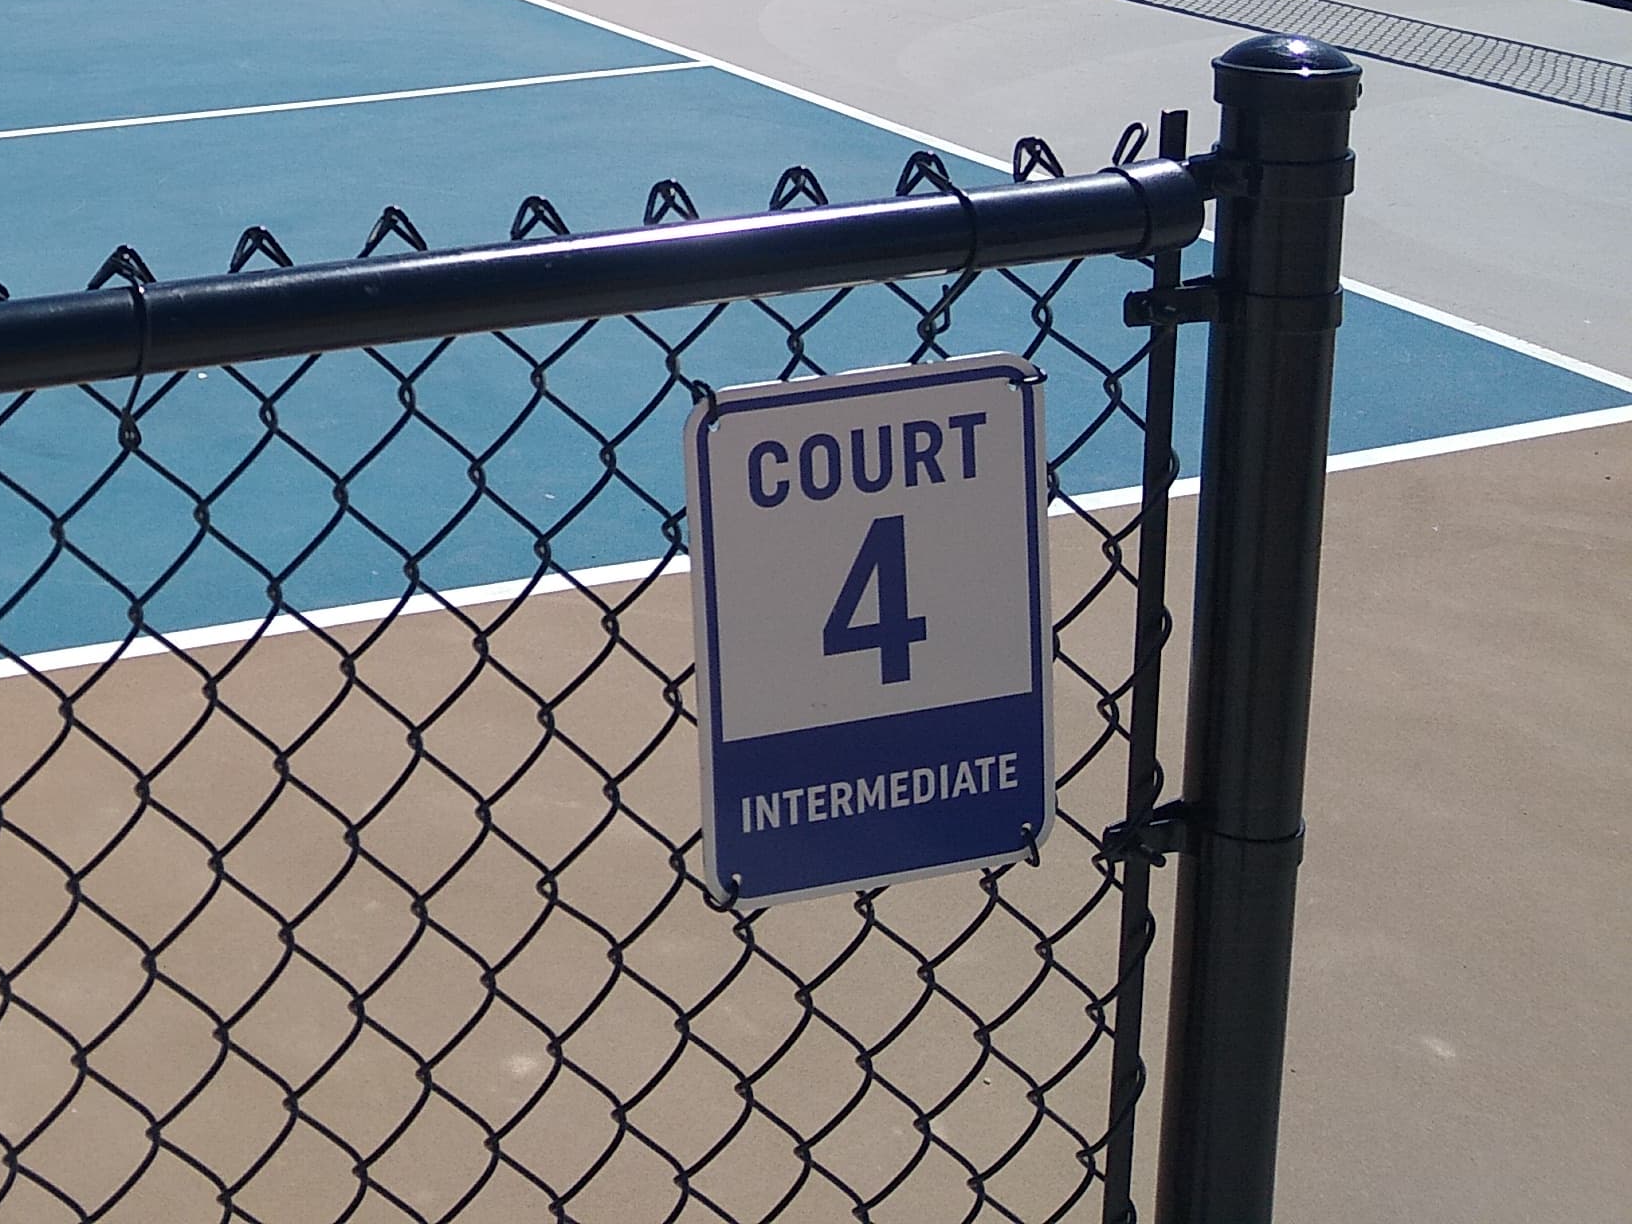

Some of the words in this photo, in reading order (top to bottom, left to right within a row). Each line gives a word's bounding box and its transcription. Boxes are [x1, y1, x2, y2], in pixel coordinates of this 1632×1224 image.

[749, 413, 986, 507] COURT
[824, 516, 926, 685] 4
[743, 753, 1018, 832] INTERMEDIATE
